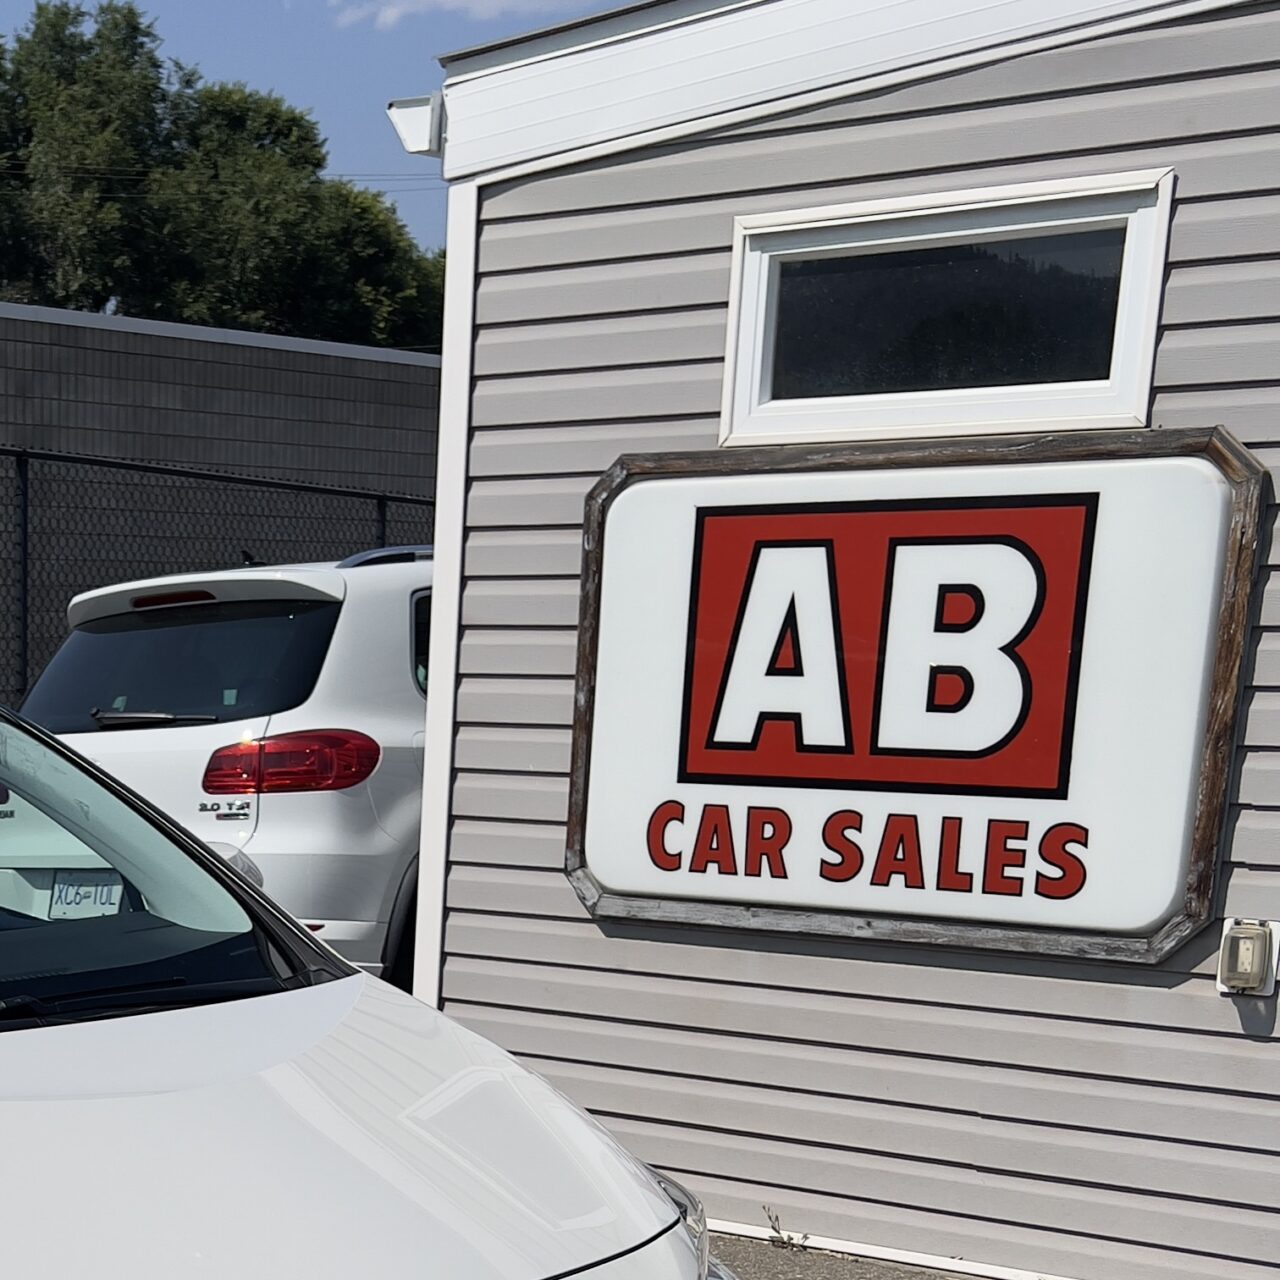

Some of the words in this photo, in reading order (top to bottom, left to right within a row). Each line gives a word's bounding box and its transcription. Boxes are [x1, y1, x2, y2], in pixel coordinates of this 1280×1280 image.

[704, 535, 1046, 760] AB
[646, 800, 793, 880] CAR
[819, 809, 1090, 900] SALES
